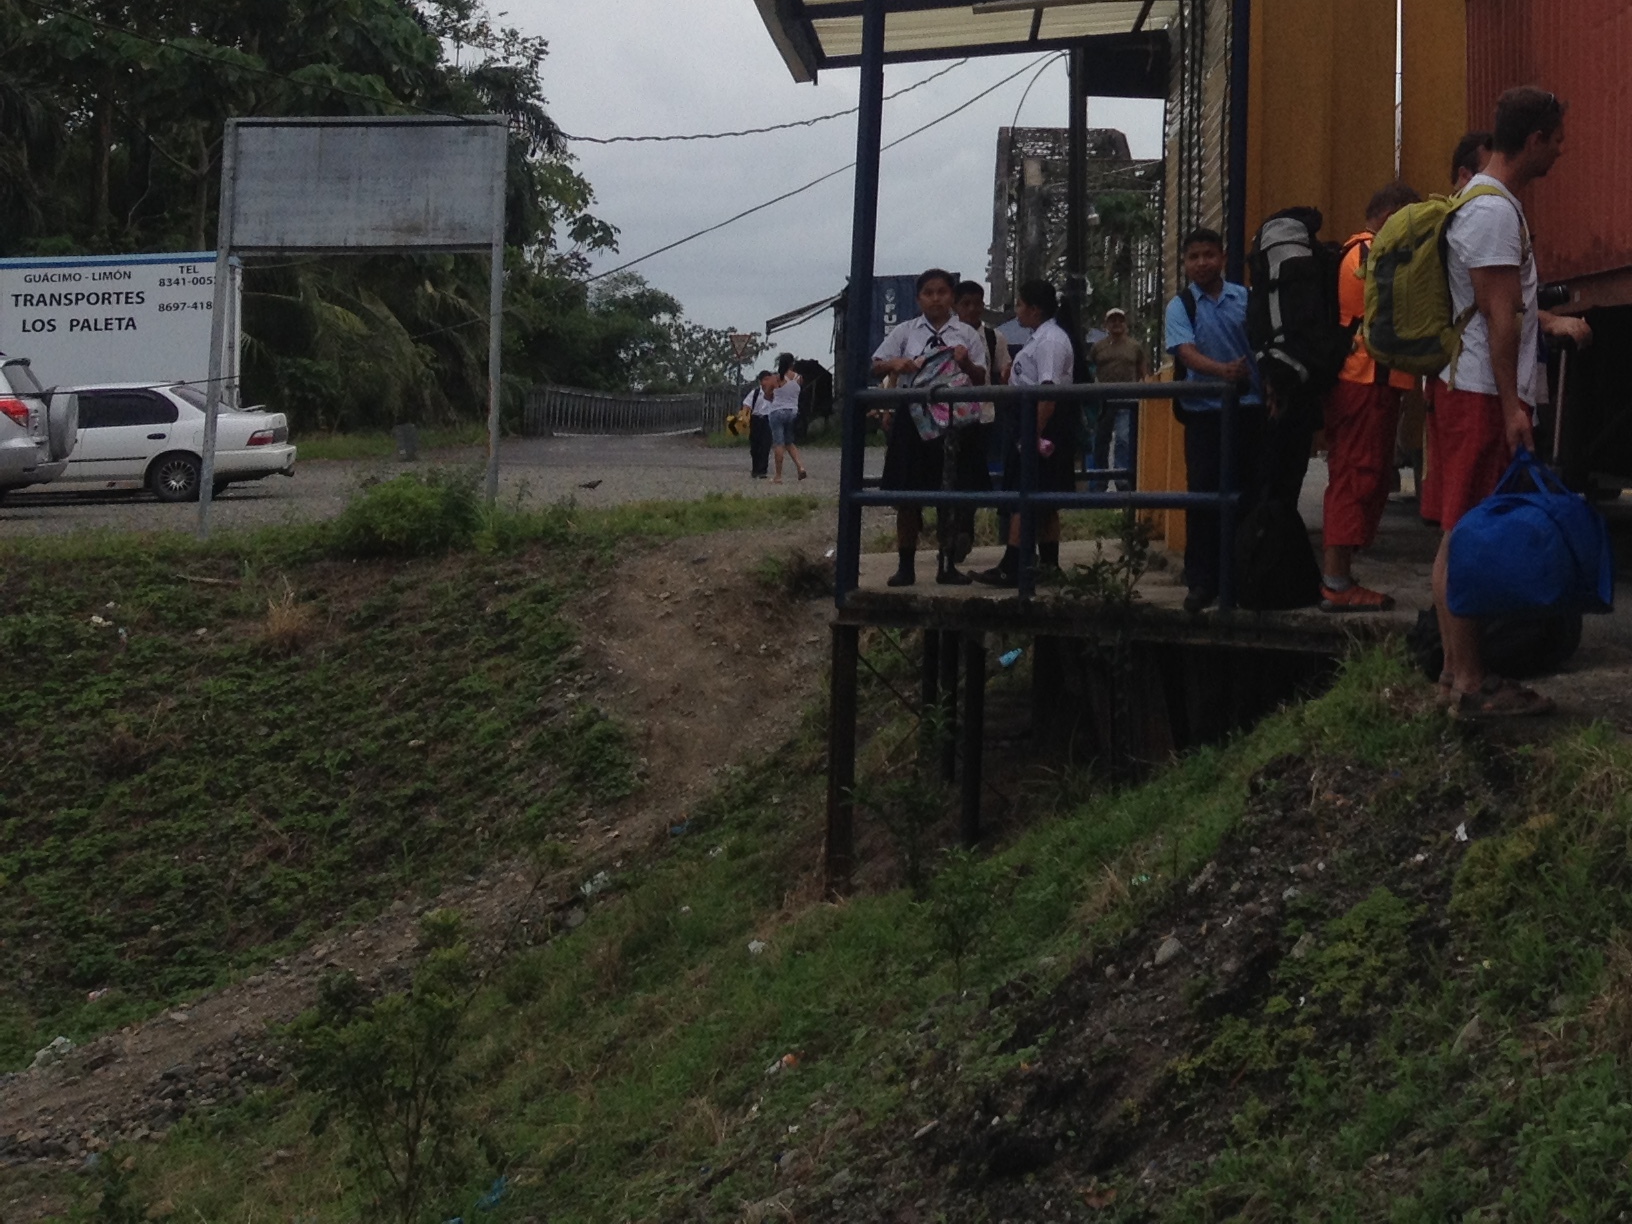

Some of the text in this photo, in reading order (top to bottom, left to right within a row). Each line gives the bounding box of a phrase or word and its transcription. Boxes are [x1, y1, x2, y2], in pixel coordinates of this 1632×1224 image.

[24, 272, 82, 283] GUÁCIMO
[92, 269, 132, 281] LIMÓN
[178, 265, 199, 274] TEL
[11, 291, 146, 308] TRANSPORTES
[158, 300, 213, 312] 8697-418
[21, 317, 137, 333] LOS PALETA
